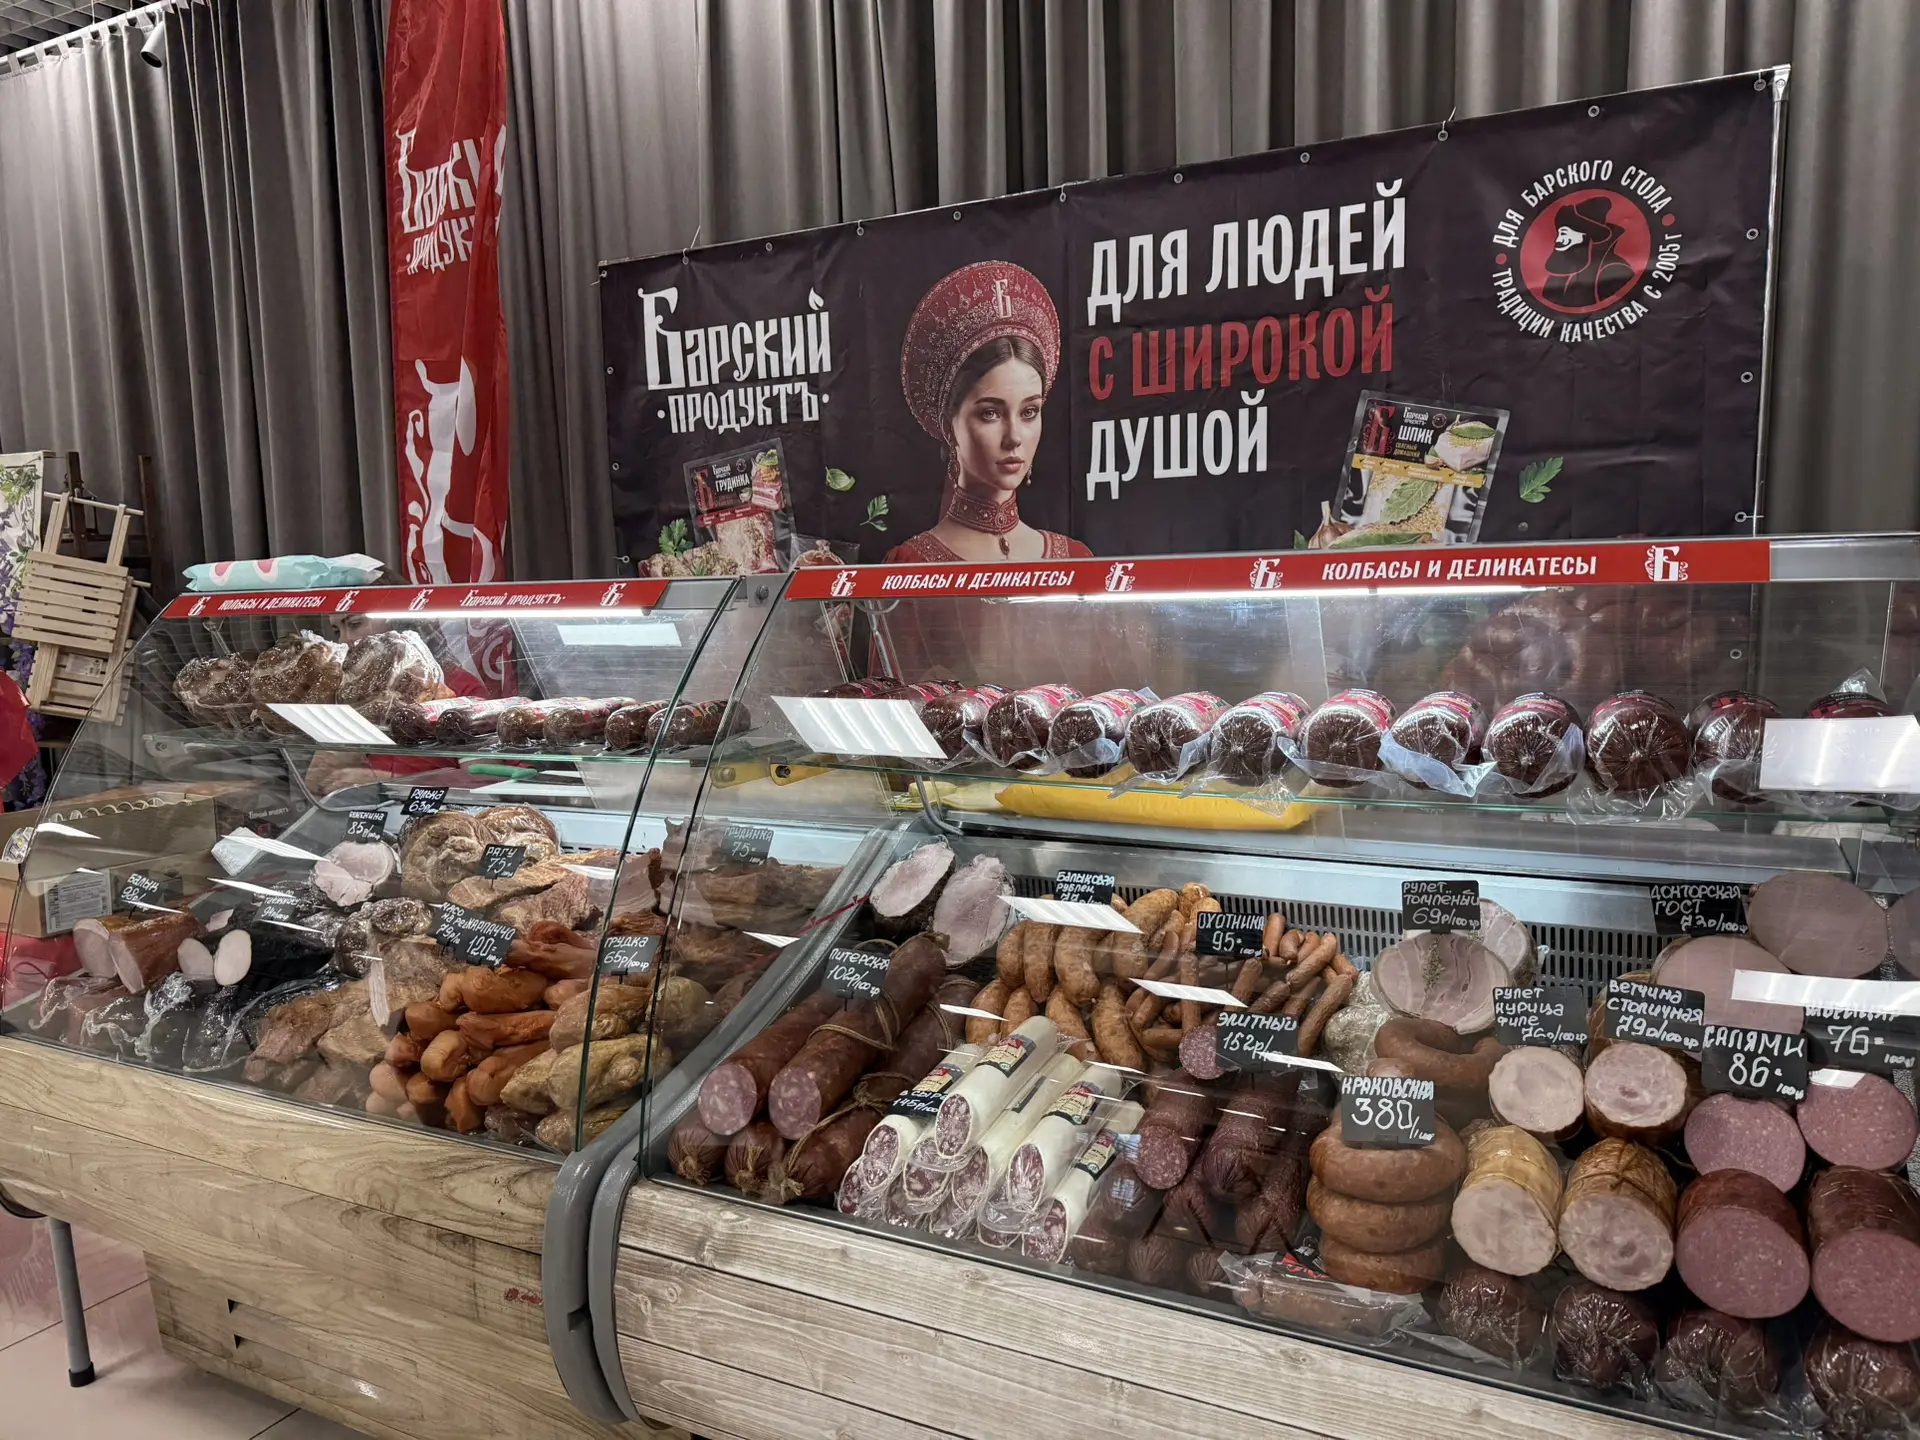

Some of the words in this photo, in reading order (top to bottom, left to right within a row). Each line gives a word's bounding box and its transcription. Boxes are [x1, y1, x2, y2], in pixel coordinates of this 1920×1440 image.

[1493, 208, 1525, 248] ДЛЯ
[1521, 160, 1613, 208] БАРСКОГО
[1620, 166, 1672, 214] СТОЛА
[1087, 229, 1188, 326] ДЛЯ
[1205, 178, 1406, 300] ЛЮДЕЙ
[1492, 268, 1555, 338] ТРАДИЦИИ
[1559, 300, 1648, 343] КАЧЕСТВА
[1643, 284, 1662, 299] С
[638, 287, 832, 391] Барский
[1089, 336, 1114, 400] С
[1132, 284, 1393, 396] ШИРОКОЙ
[1086, 388, 1268, 501] ДУШОЙ
[1397, 425, 1435, 444] ШПИК
[715, 473, 751, 492] ГРУДИНКА
[882, 573, 953, 590] КОЛБАСЫ
[955, 573, 968, 588] И
[968, 570, 1075, 590] ДЕЛИКАТЕСЫ
[1322, 560, 1420, 580] КОЛБАСЫ
[1427, 560, 1442, 576] И
[1447, 556, 1597, 580] ДЕЛИКАТЕСЫ
[218, 598, 260, 610] КОЛБАСЫ
[259, 598, 266, 609] И
[265, 596, 327, 610] ДЕЛИКАТЕСЫ
[1655, 899, 1705, 916] ГОСТ
[1703, 1025, 1805, 1057] САЛЯМИ
[1341, 1077, 1434, 1100] КРАКОВСКАЯ
